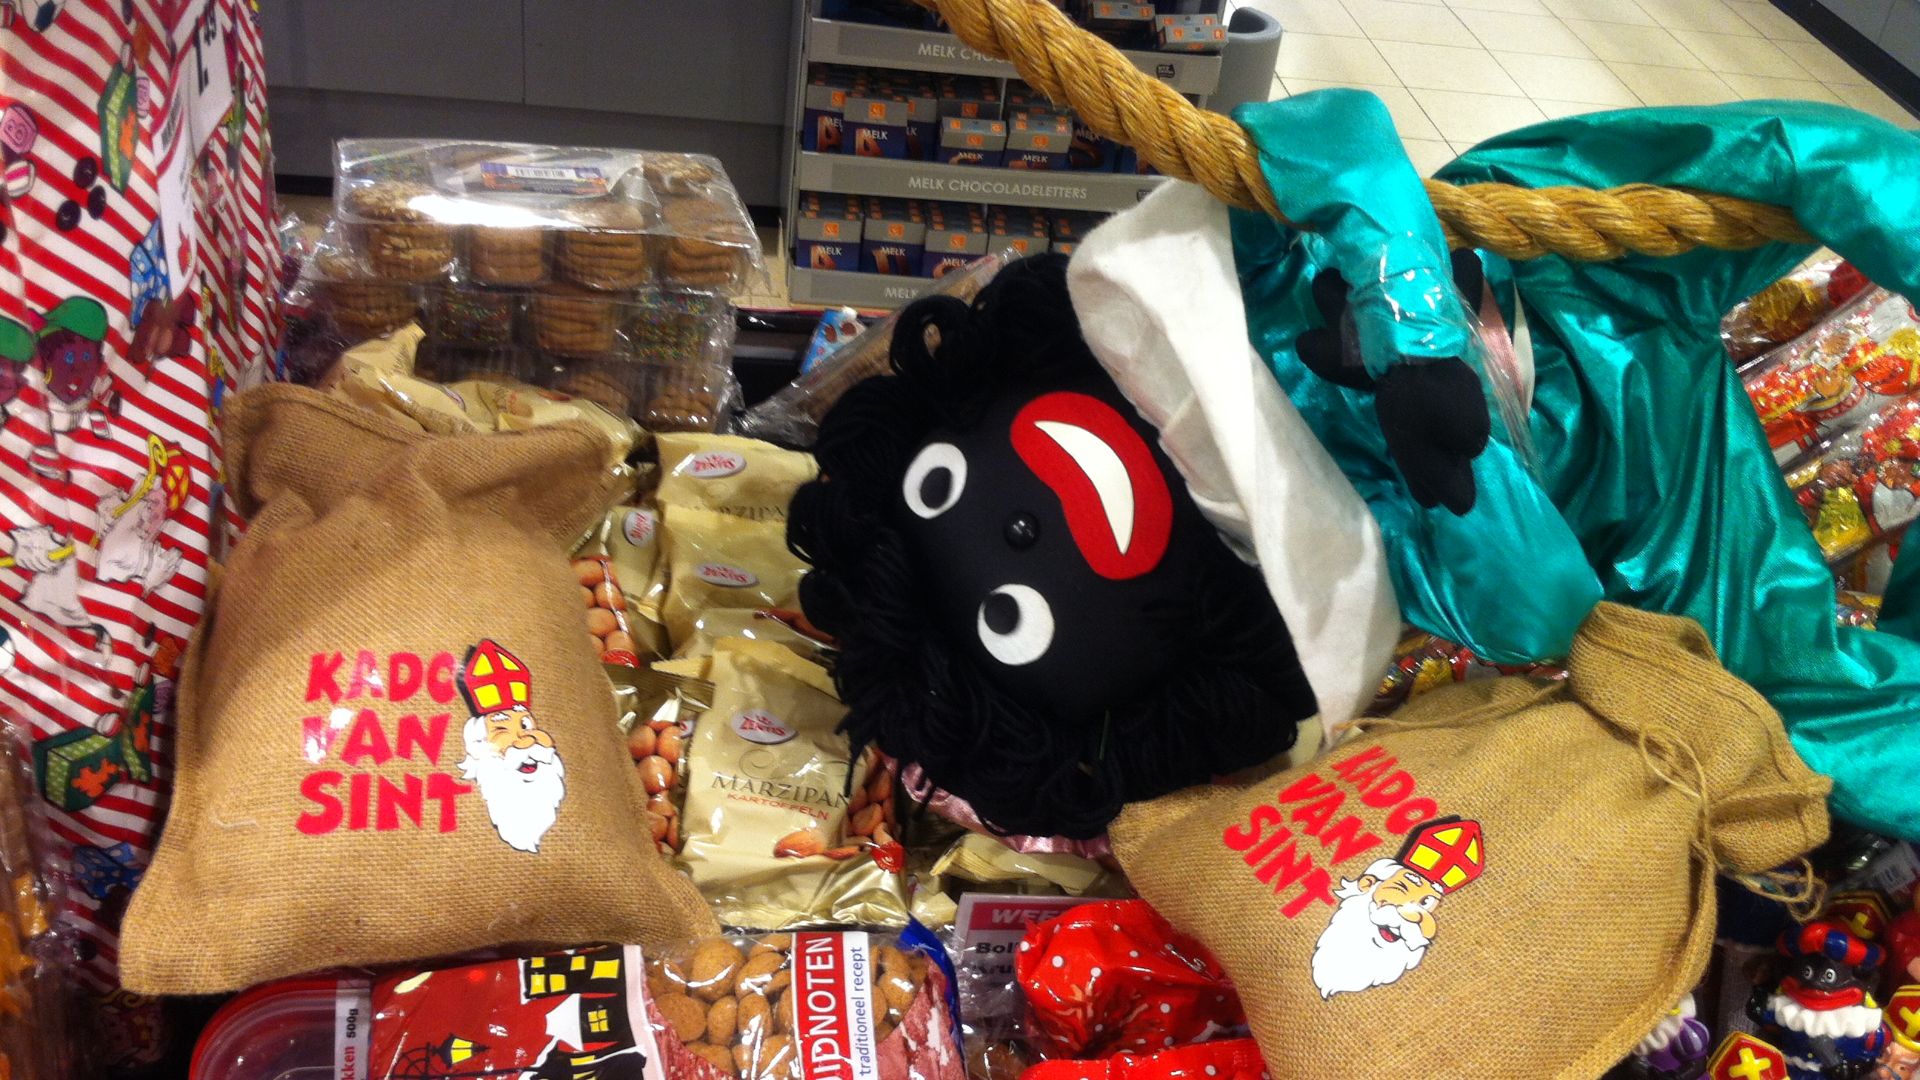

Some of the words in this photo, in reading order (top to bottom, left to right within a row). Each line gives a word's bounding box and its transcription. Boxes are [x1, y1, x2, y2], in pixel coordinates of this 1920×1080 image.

[918, 43, 955, 59] MELK
[862, 129, 888, 141] MELK
[1022, 153, 1048, 164] MELK
[908, 176, 944, 191] MELK
[949, 179, 1088, 200] CHOCOLADELETTERS
[817, 245, 842, 257] MELK
[881, 246, 906, 257] MELK
[942, 256, 968, 268] MELK
[884, 286, 919, 299] MELK
[304, 650, 459, 705] KADO
[302, 707, 453, 767] VAN
[294, 770, 473, 836] SINT
[711, 772, 850, 809] MARZIPAN
[1331, 744, 1438, 836] KADO
[727, 792, 831, 821] KARTOFFELN
[1278, 772, 1384, 867] VAN
[1222, 804, 1337, 920] SINT
[975, 942, 1019, 954] Bol
[850, 946, 867, 992] recept
[346, 1008, 359, 1039] 500g
[851, 996, 873, 1077] traditioneel
